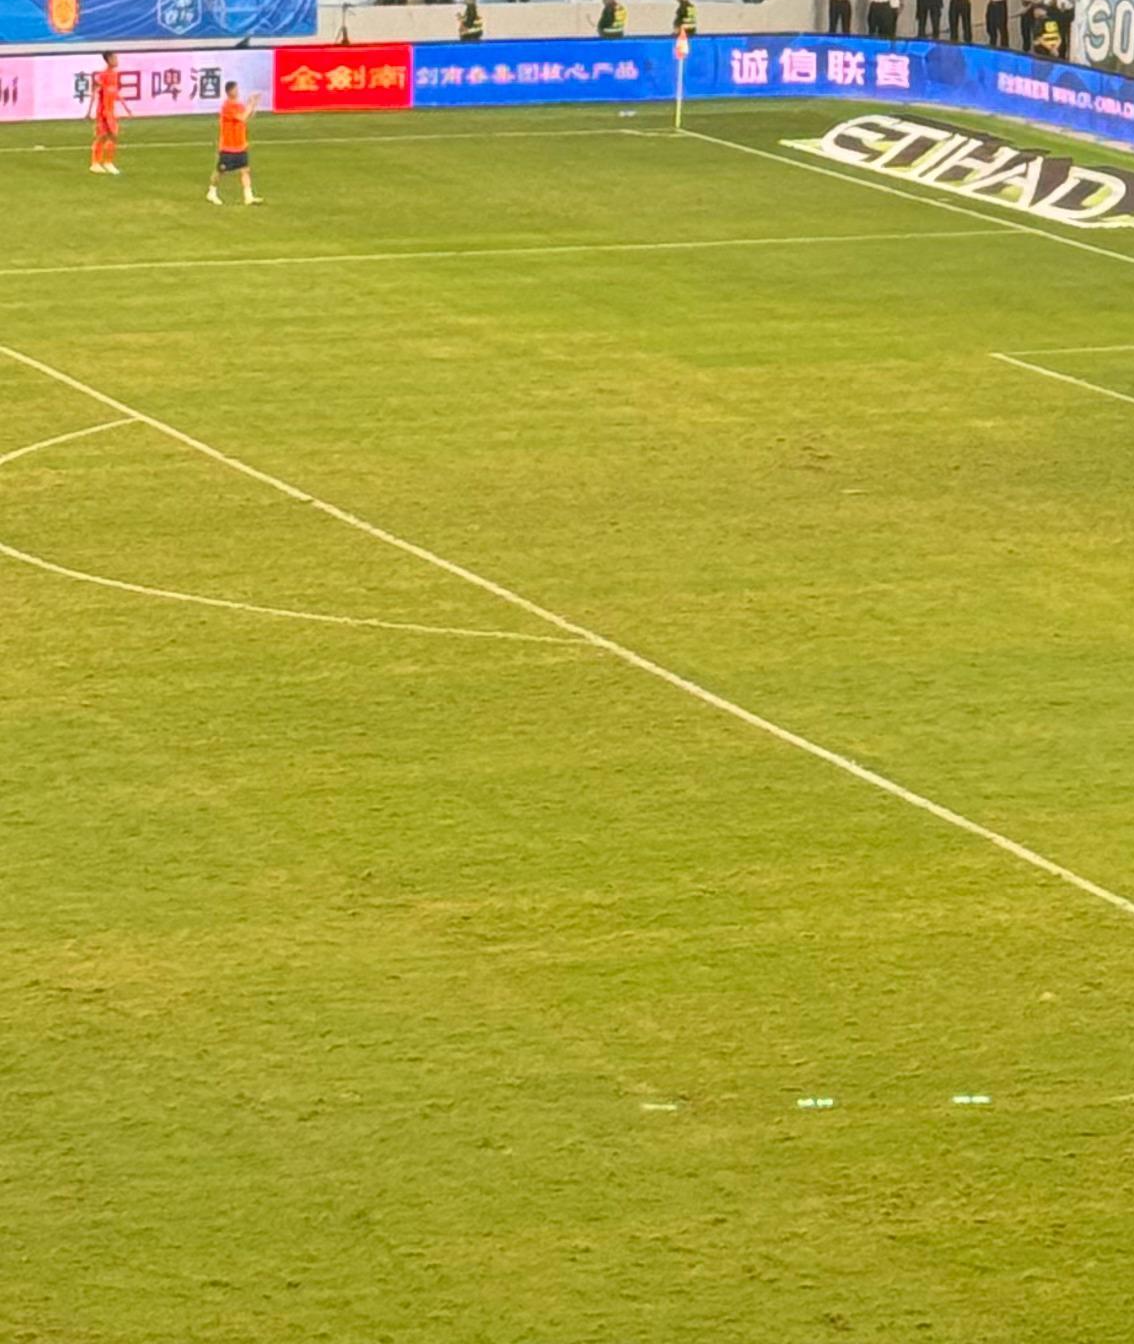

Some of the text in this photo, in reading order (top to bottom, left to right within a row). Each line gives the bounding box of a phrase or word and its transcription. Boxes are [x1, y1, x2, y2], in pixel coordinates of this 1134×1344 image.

[731, 48, 911, 88] 诚信联赛
[819, 113, 1129, 221] ETIHAD
